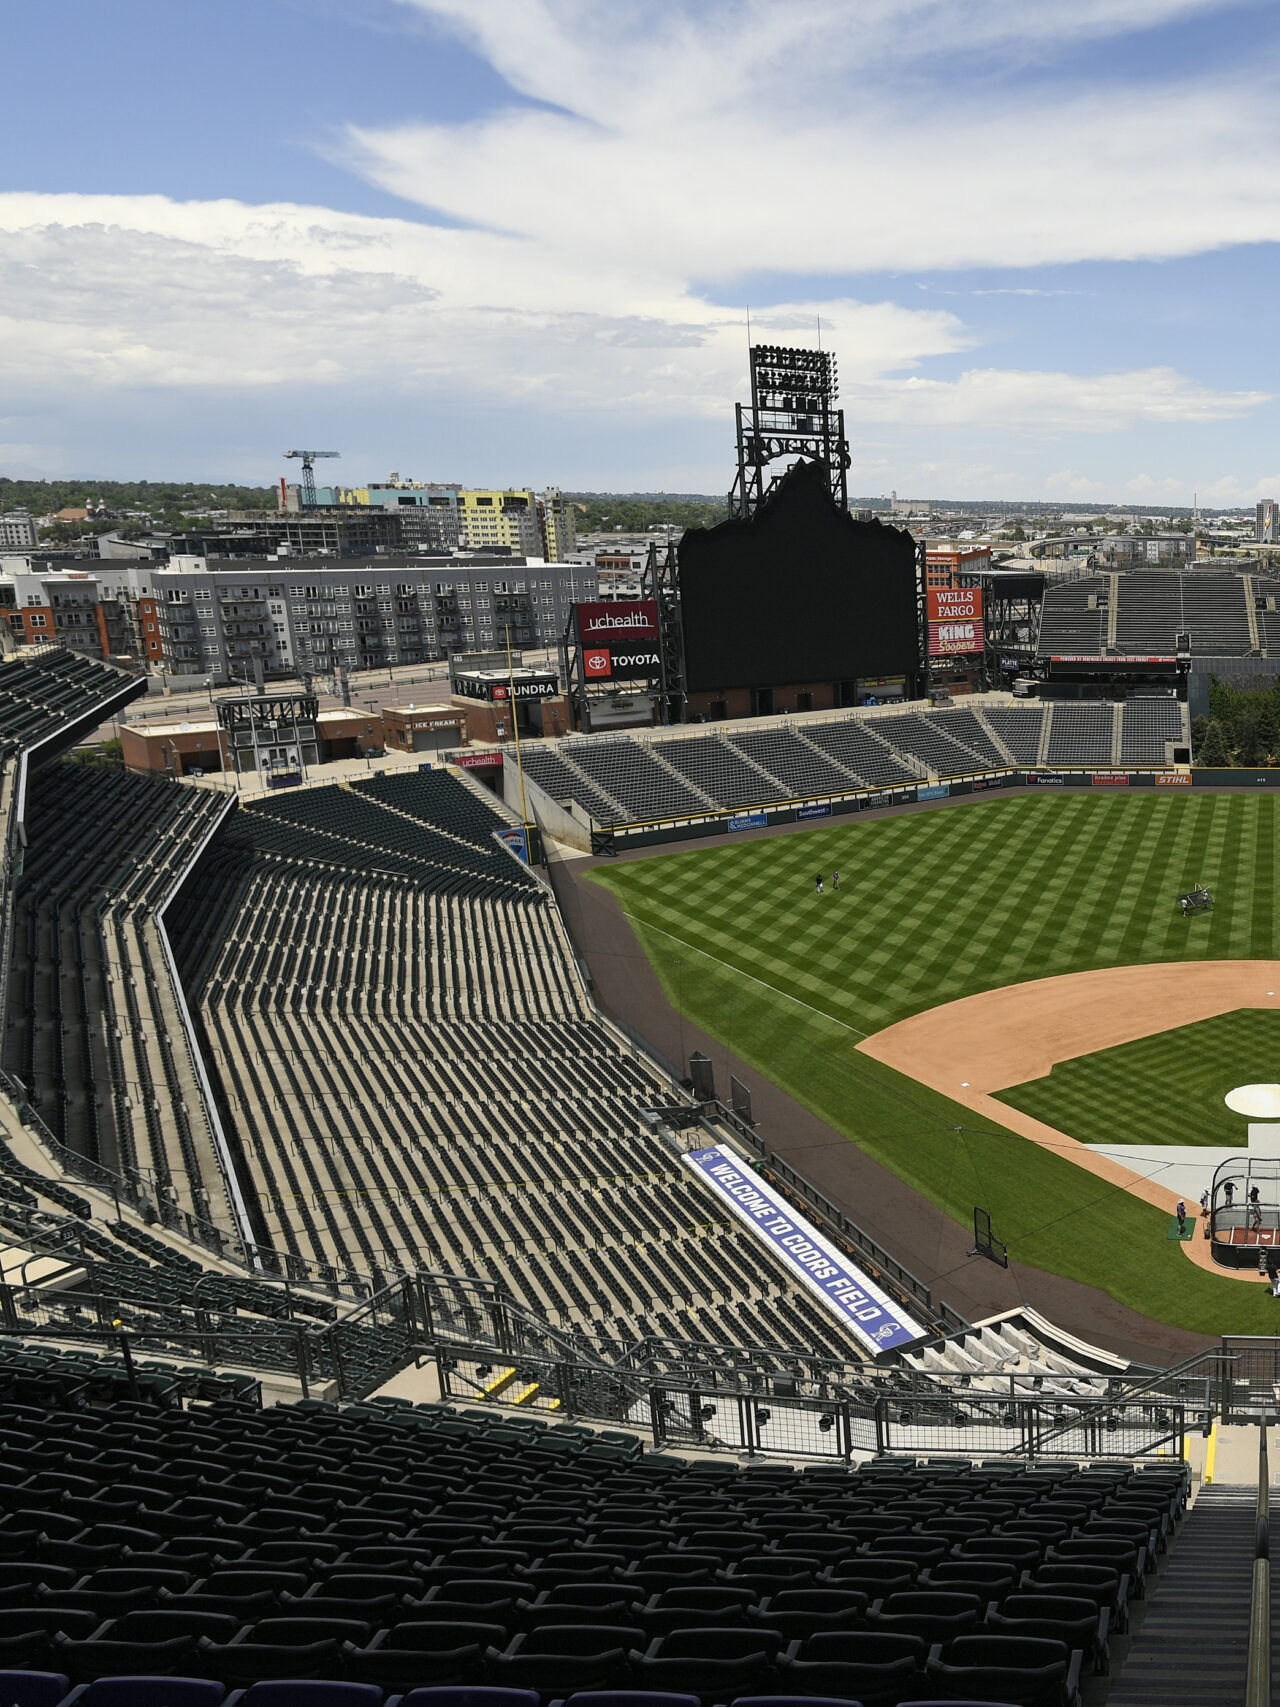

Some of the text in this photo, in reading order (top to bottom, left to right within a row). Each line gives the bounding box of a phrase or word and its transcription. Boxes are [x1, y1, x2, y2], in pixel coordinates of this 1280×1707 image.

[936, 592, 974, 603] WELLS
[938, 605, 974, 616] FARGO
[589, 611, 649, 630] uchealth
[938, 625, 975, 640] KING
[939, 640, 976, 654] Soopers
[611, 654, 661, 667] TOYOTA
[506, 684, 554, 697] TUNDRA
[429, 720, 456, 728] CREAM
[462, 755, 496, 767] uchealth
[1037, 776, 1062, 784] Fanatics
[1159, 776, 1189, 784] STIHL
[798, 808, 826, 816] Southwest
[709, 1162, 883, 1322] WELCOME TO COORS FIELD
